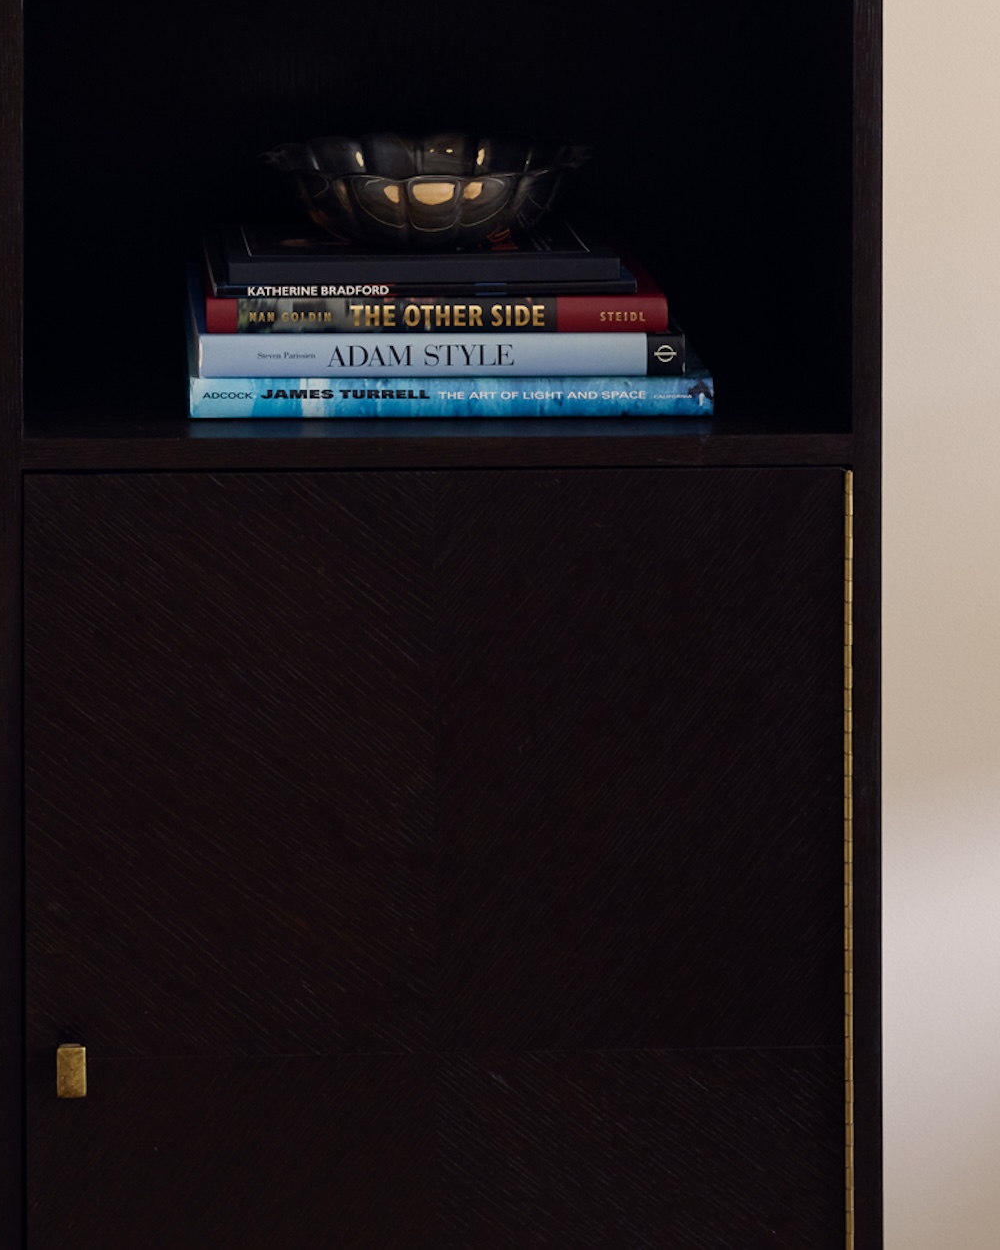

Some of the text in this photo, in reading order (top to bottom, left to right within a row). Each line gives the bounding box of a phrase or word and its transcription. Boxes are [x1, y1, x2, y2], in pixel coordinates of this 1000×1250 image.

[247, 285, 389, 297] KATHERINE BRADFORD
[249, 305, 646, 327] NAN GOLDIN THE OTHER SIDE STEIDL
[257, 344, 515, 367] Steven Parissien ADAM STYLE
[203, 392, 252, 400] ADCOCK
[261, 389, 334, 399] JAMES
[339, 389, 430, 399] TURRELL
[438, 391, 465, 400] THE
[469, 391, 497, 400] ART
[501, 391, 520, 400] OF
[523, 391, 563, 400] LIGHT
[567, 391, 598, 400] AND
[601, 391, 646, 400] SPACE
